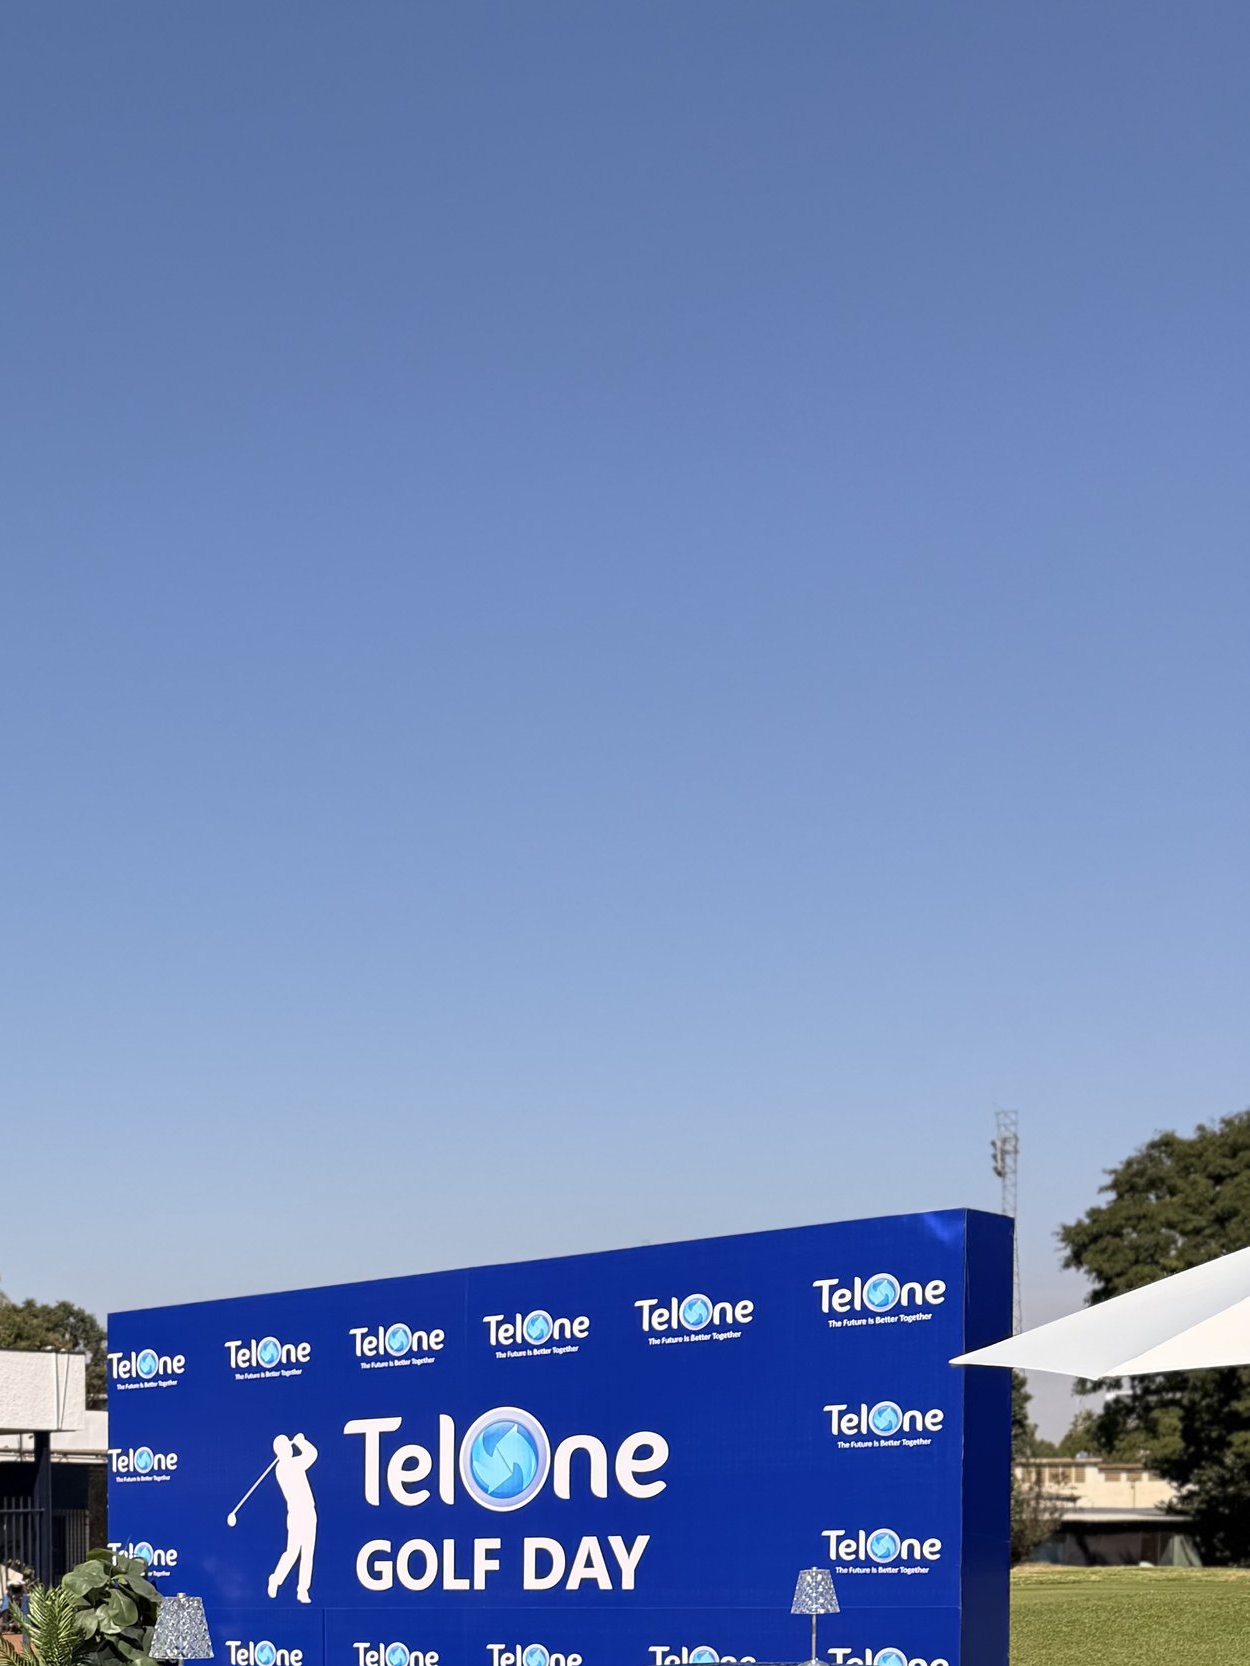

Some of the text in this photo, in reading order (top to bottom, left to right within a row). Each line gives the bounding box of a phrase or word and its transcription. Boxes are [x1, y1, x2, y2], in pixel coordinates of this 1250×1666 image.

[812, 1272, 947, 1313] TelOne
[482, 1309, 590, 1345] TelOne
[634, 1293, 754, 1331] TelOne
[828, 1312, 932, 1328] The Future Is Better Together
[224, 1336, 311, 1368] TelOne
[349, 1323, 445, 1357] TelOne
[107, 1348, 186, 1379] TelOne
[823, 1401, 944, 1437] TelOne
[107, 1446, 178, 1474] TelOne
[343, 1406, 670, 1512] TelOne
[356, 1534, 651, 1591] GOLF DAY
[821, 1528, 942, 1563] TelOne
